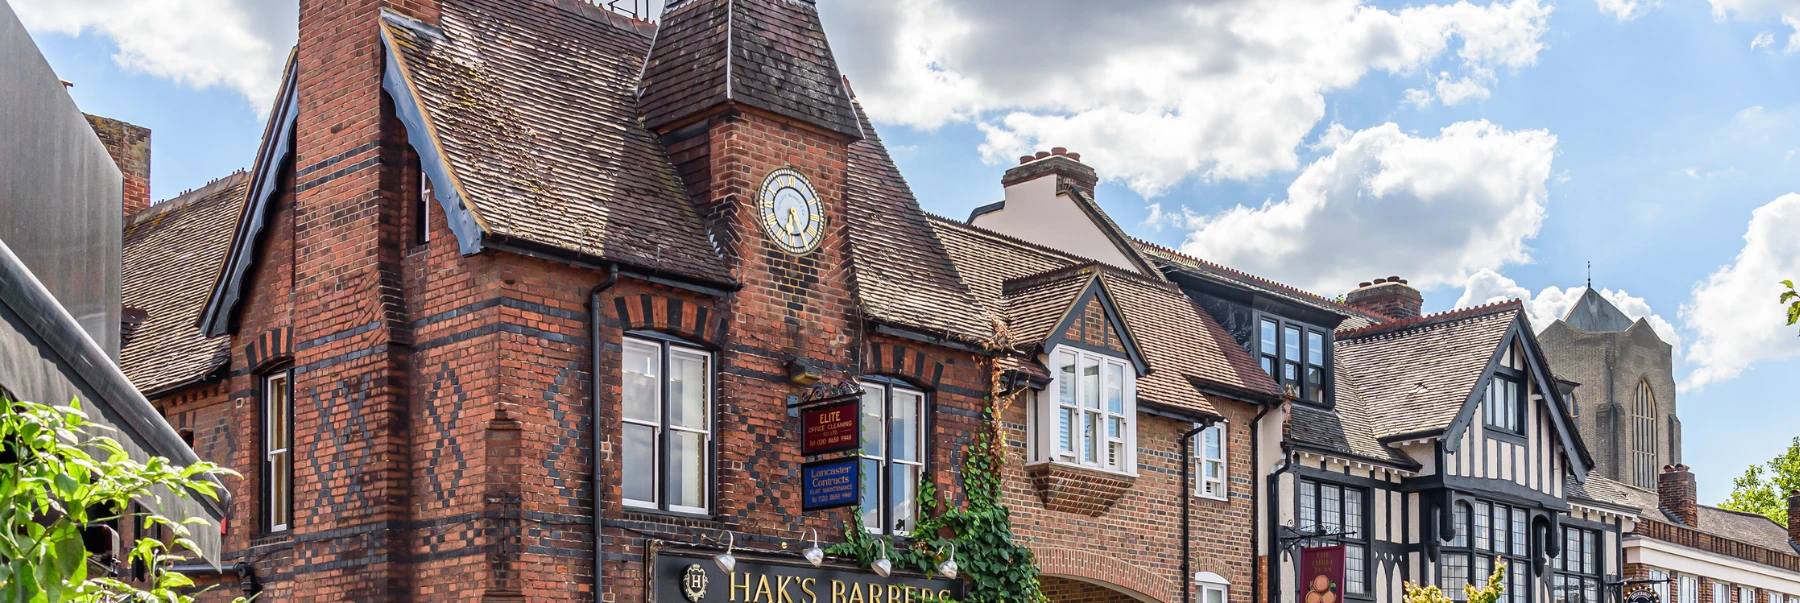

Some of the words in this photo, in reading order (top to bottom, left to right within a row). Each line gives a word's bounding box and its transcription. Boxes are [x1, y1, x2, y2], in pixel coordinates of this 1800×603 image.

[820, 411, 840, 424] ELITE
[827, 421, 852, 430] CLEANING
[811, 466, 851, 478] Lancaster
[812, 476, 849, 487] Contracts
[823, 484, 852, 492] MAINTENANCE
[728, 571, 818, 603] HAK'S
